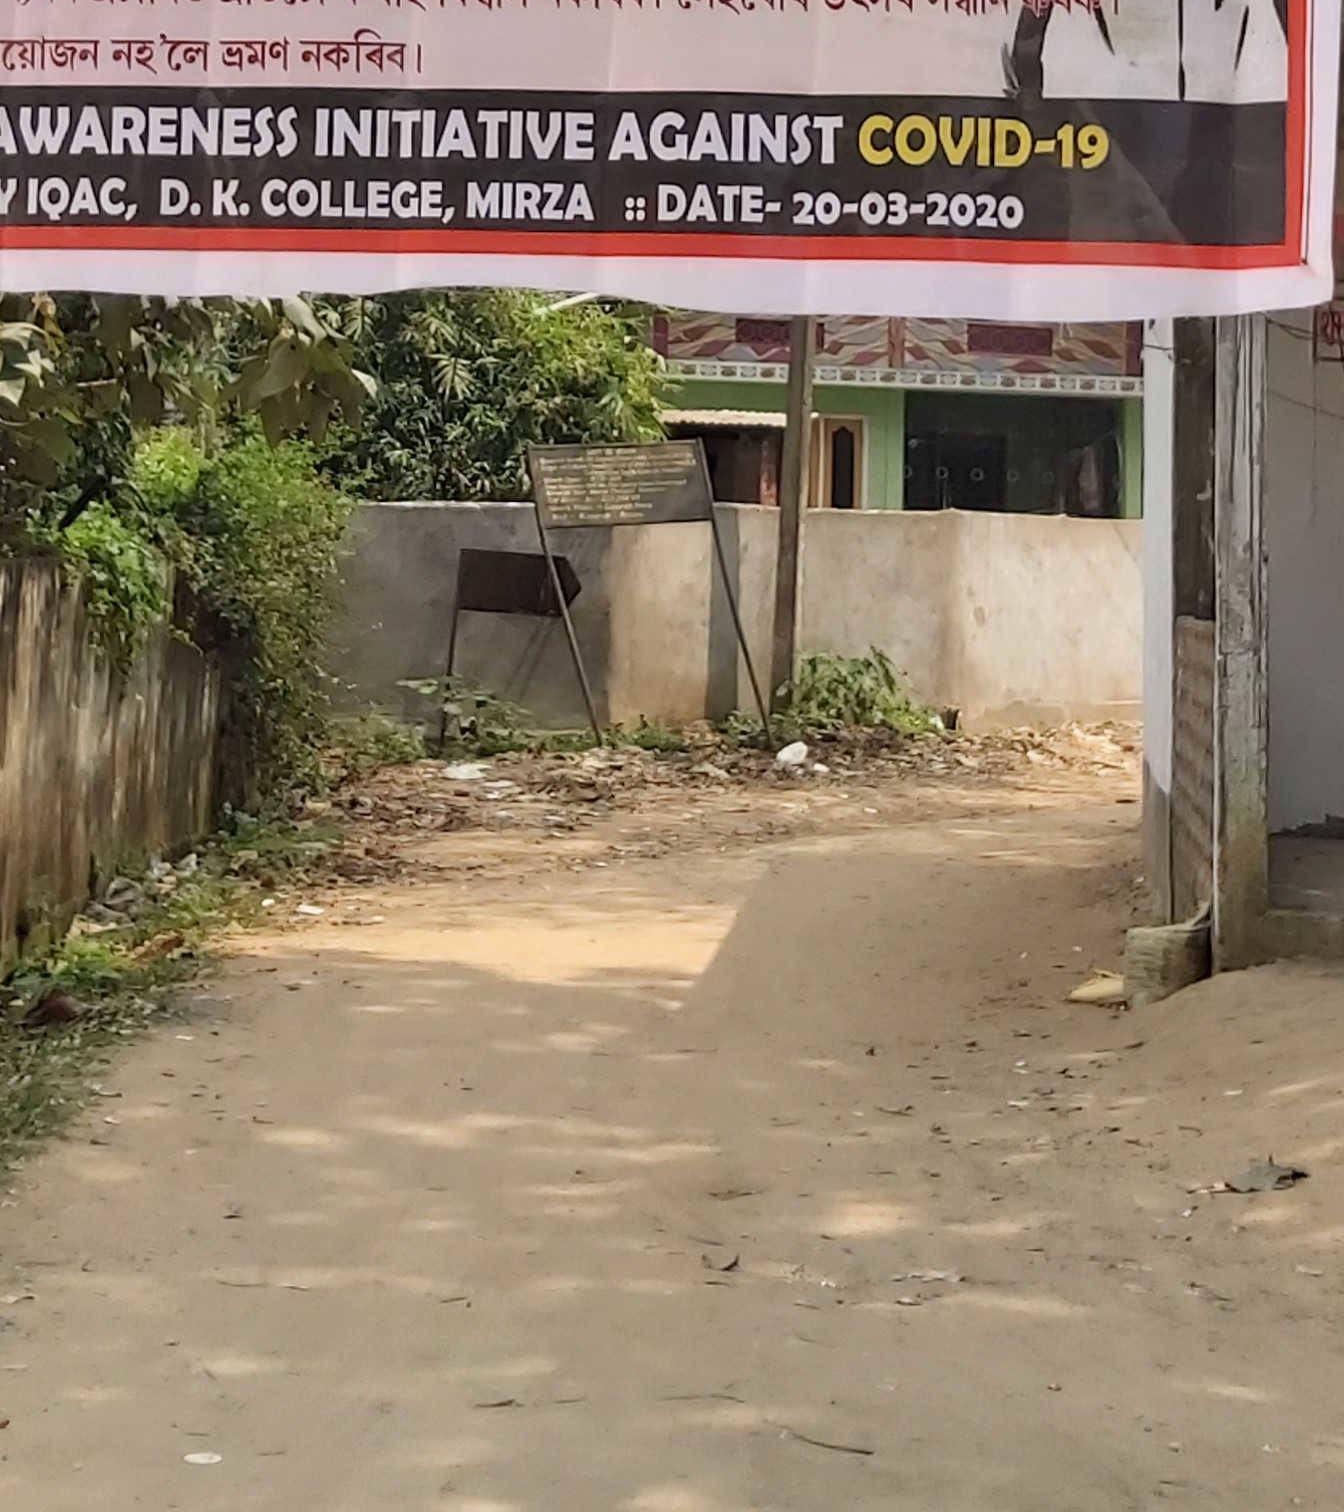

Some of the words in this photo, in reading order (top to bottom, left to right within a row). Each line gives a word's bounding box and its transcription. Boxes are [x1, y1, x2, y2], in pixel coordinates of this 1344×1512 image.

[218, 35, 291, 73] ভ্ৰমণ
[314, 107, 595, 161] INITIATIVE
[607, 111, 844, 165] AGAINST
[858, 114, 1109, 169] COVID-19
[27, 176, 138, 221] IQAC,
[159, 178, 201, 216] D.
[212, 178, 250, 217] K.
[260, 178, 456, 224] COLLEGE,
[466, 181, 595, 221] MIRZA
[657, 183, 782, 223] DATE-
[792, 191, 1024, 229] 20-03-2020
